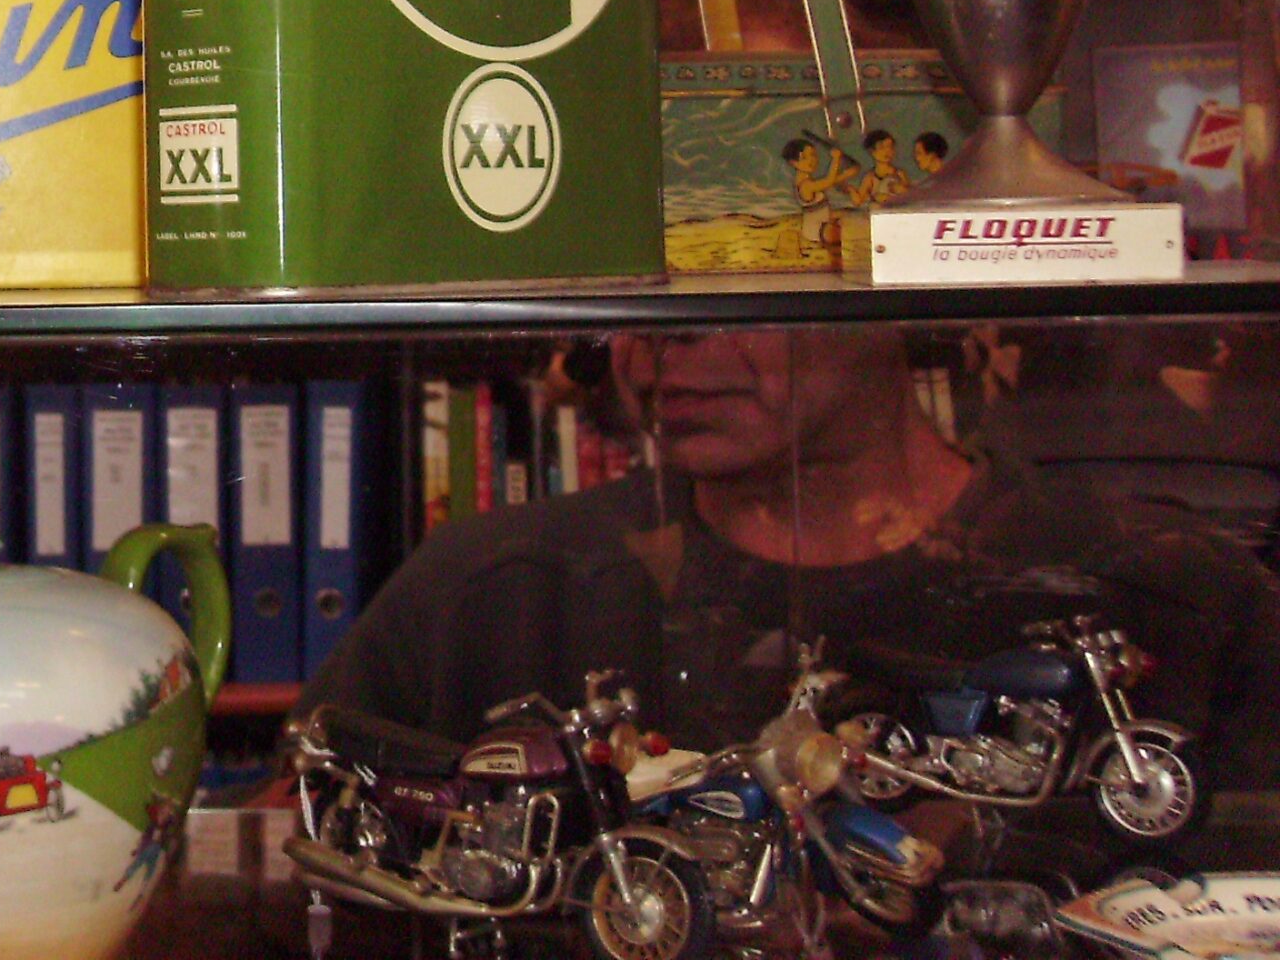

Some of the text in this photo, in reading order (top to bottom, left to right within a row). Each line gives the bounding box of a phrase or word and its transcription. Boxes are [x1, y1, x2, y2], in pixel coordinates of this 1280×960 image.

[168, 59, 221, 74] CASTROL
[166, 121, 226, 138] CASTROL
[460, 123, 546, 170] XXL
[166, 147, 232, 185] XXL
[933, 217, 1117, 245] FLOQUET
[933, 246, 1119, 264] la bougie dynamique
